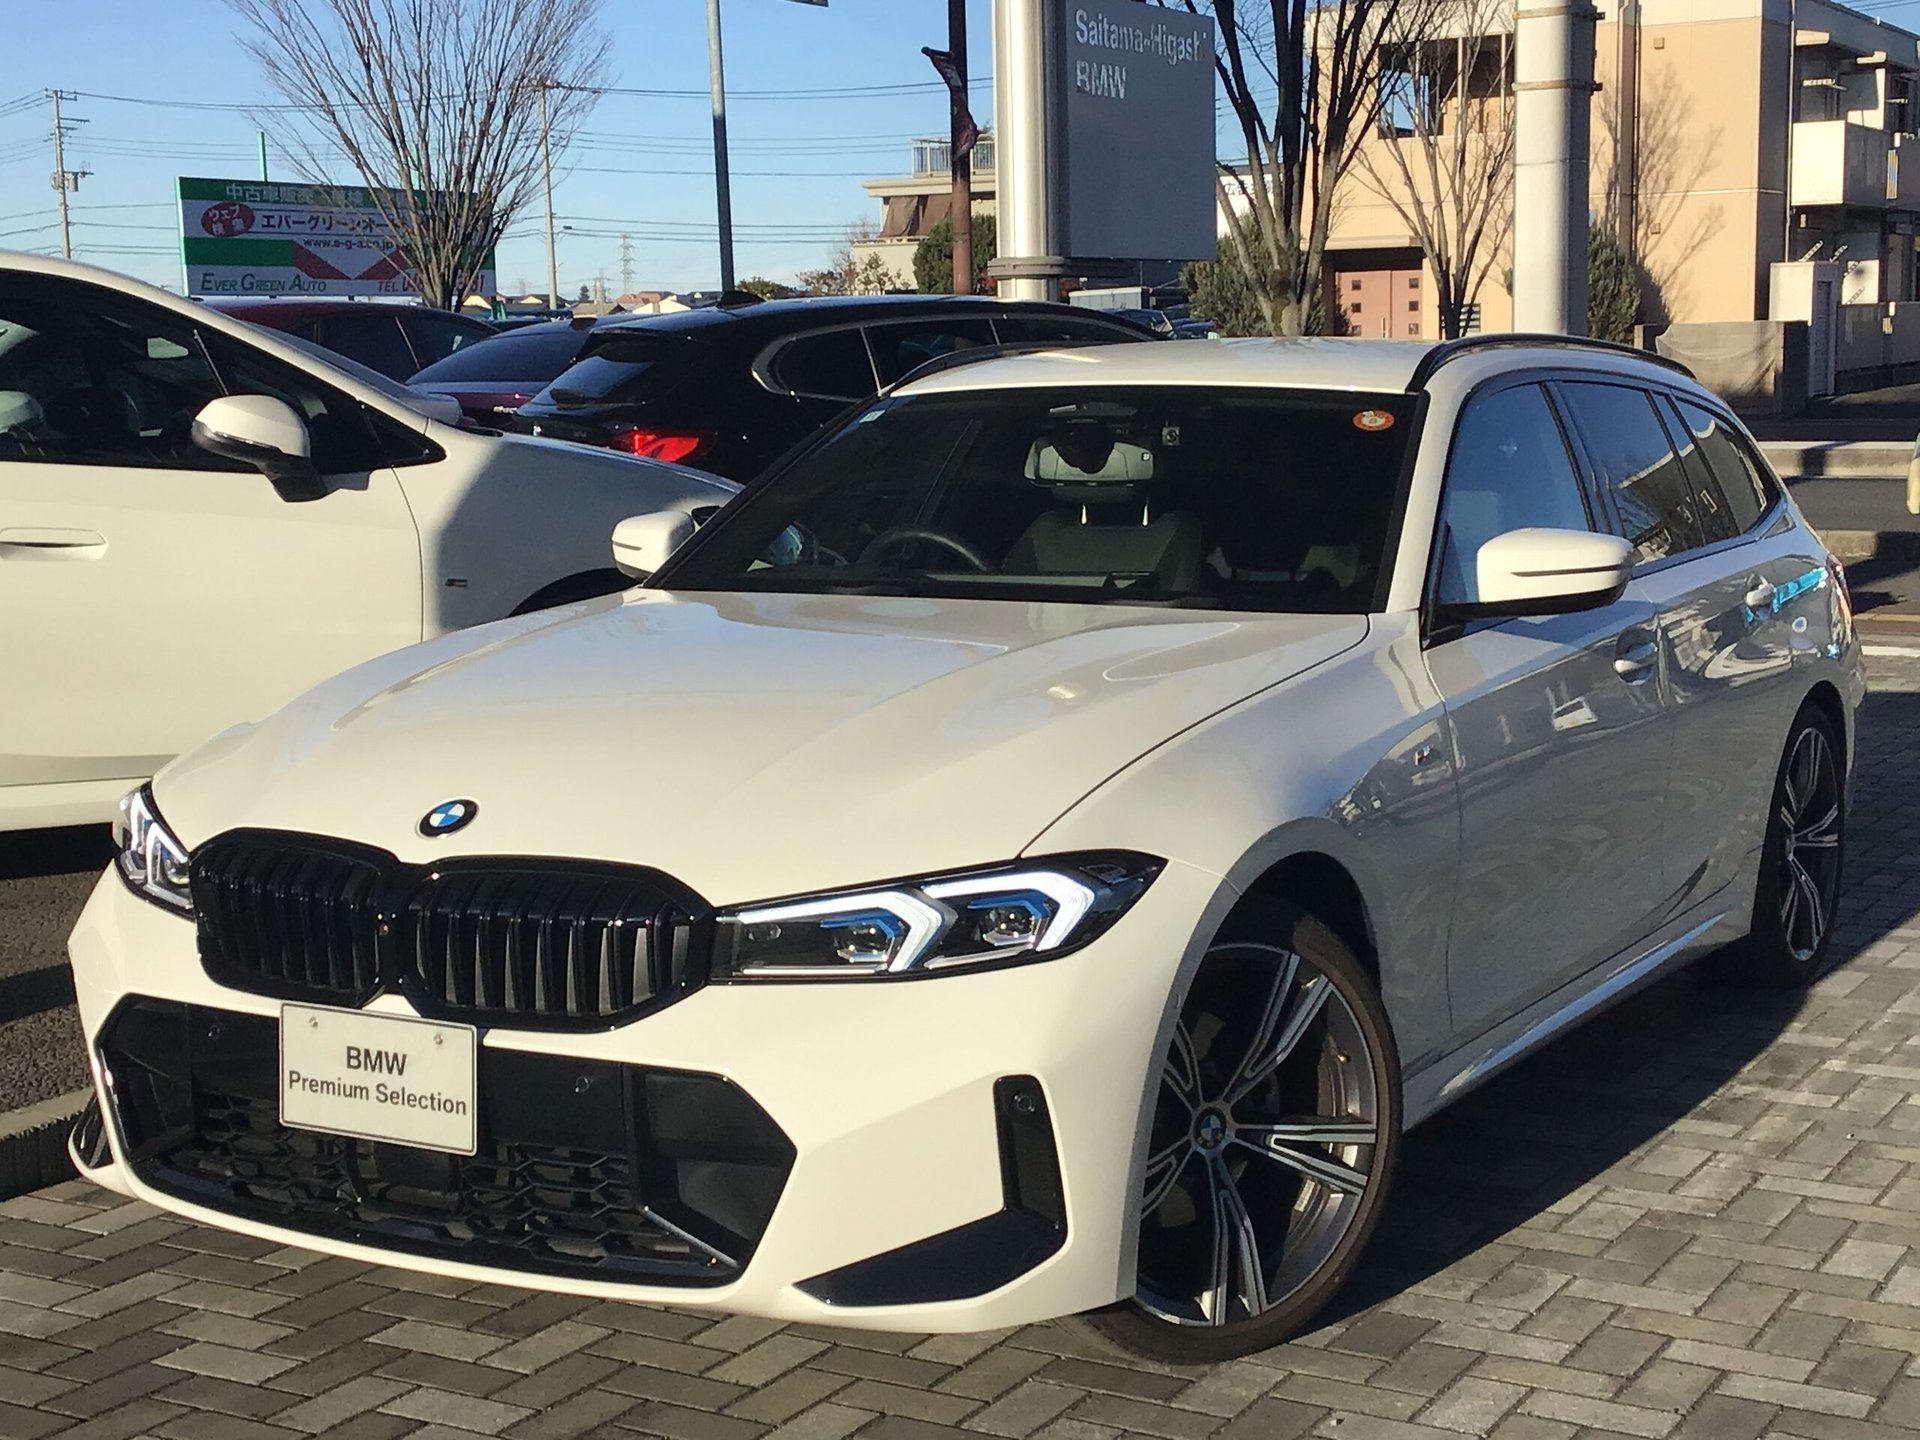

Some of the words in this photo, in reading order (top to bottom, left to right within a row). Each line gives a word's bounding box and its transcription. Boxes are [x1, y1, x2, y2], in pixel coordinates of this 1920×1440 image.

[1076, 60, 1127, 99] BMW
[288, 273, 327, 292] AUTO
[377, 281, 399, 293] TEL
[346, 1045, 407, 1076] BMW
[288, 1070, 370, 1101] Premium
[375, 1082, 467, 1116] Selection
